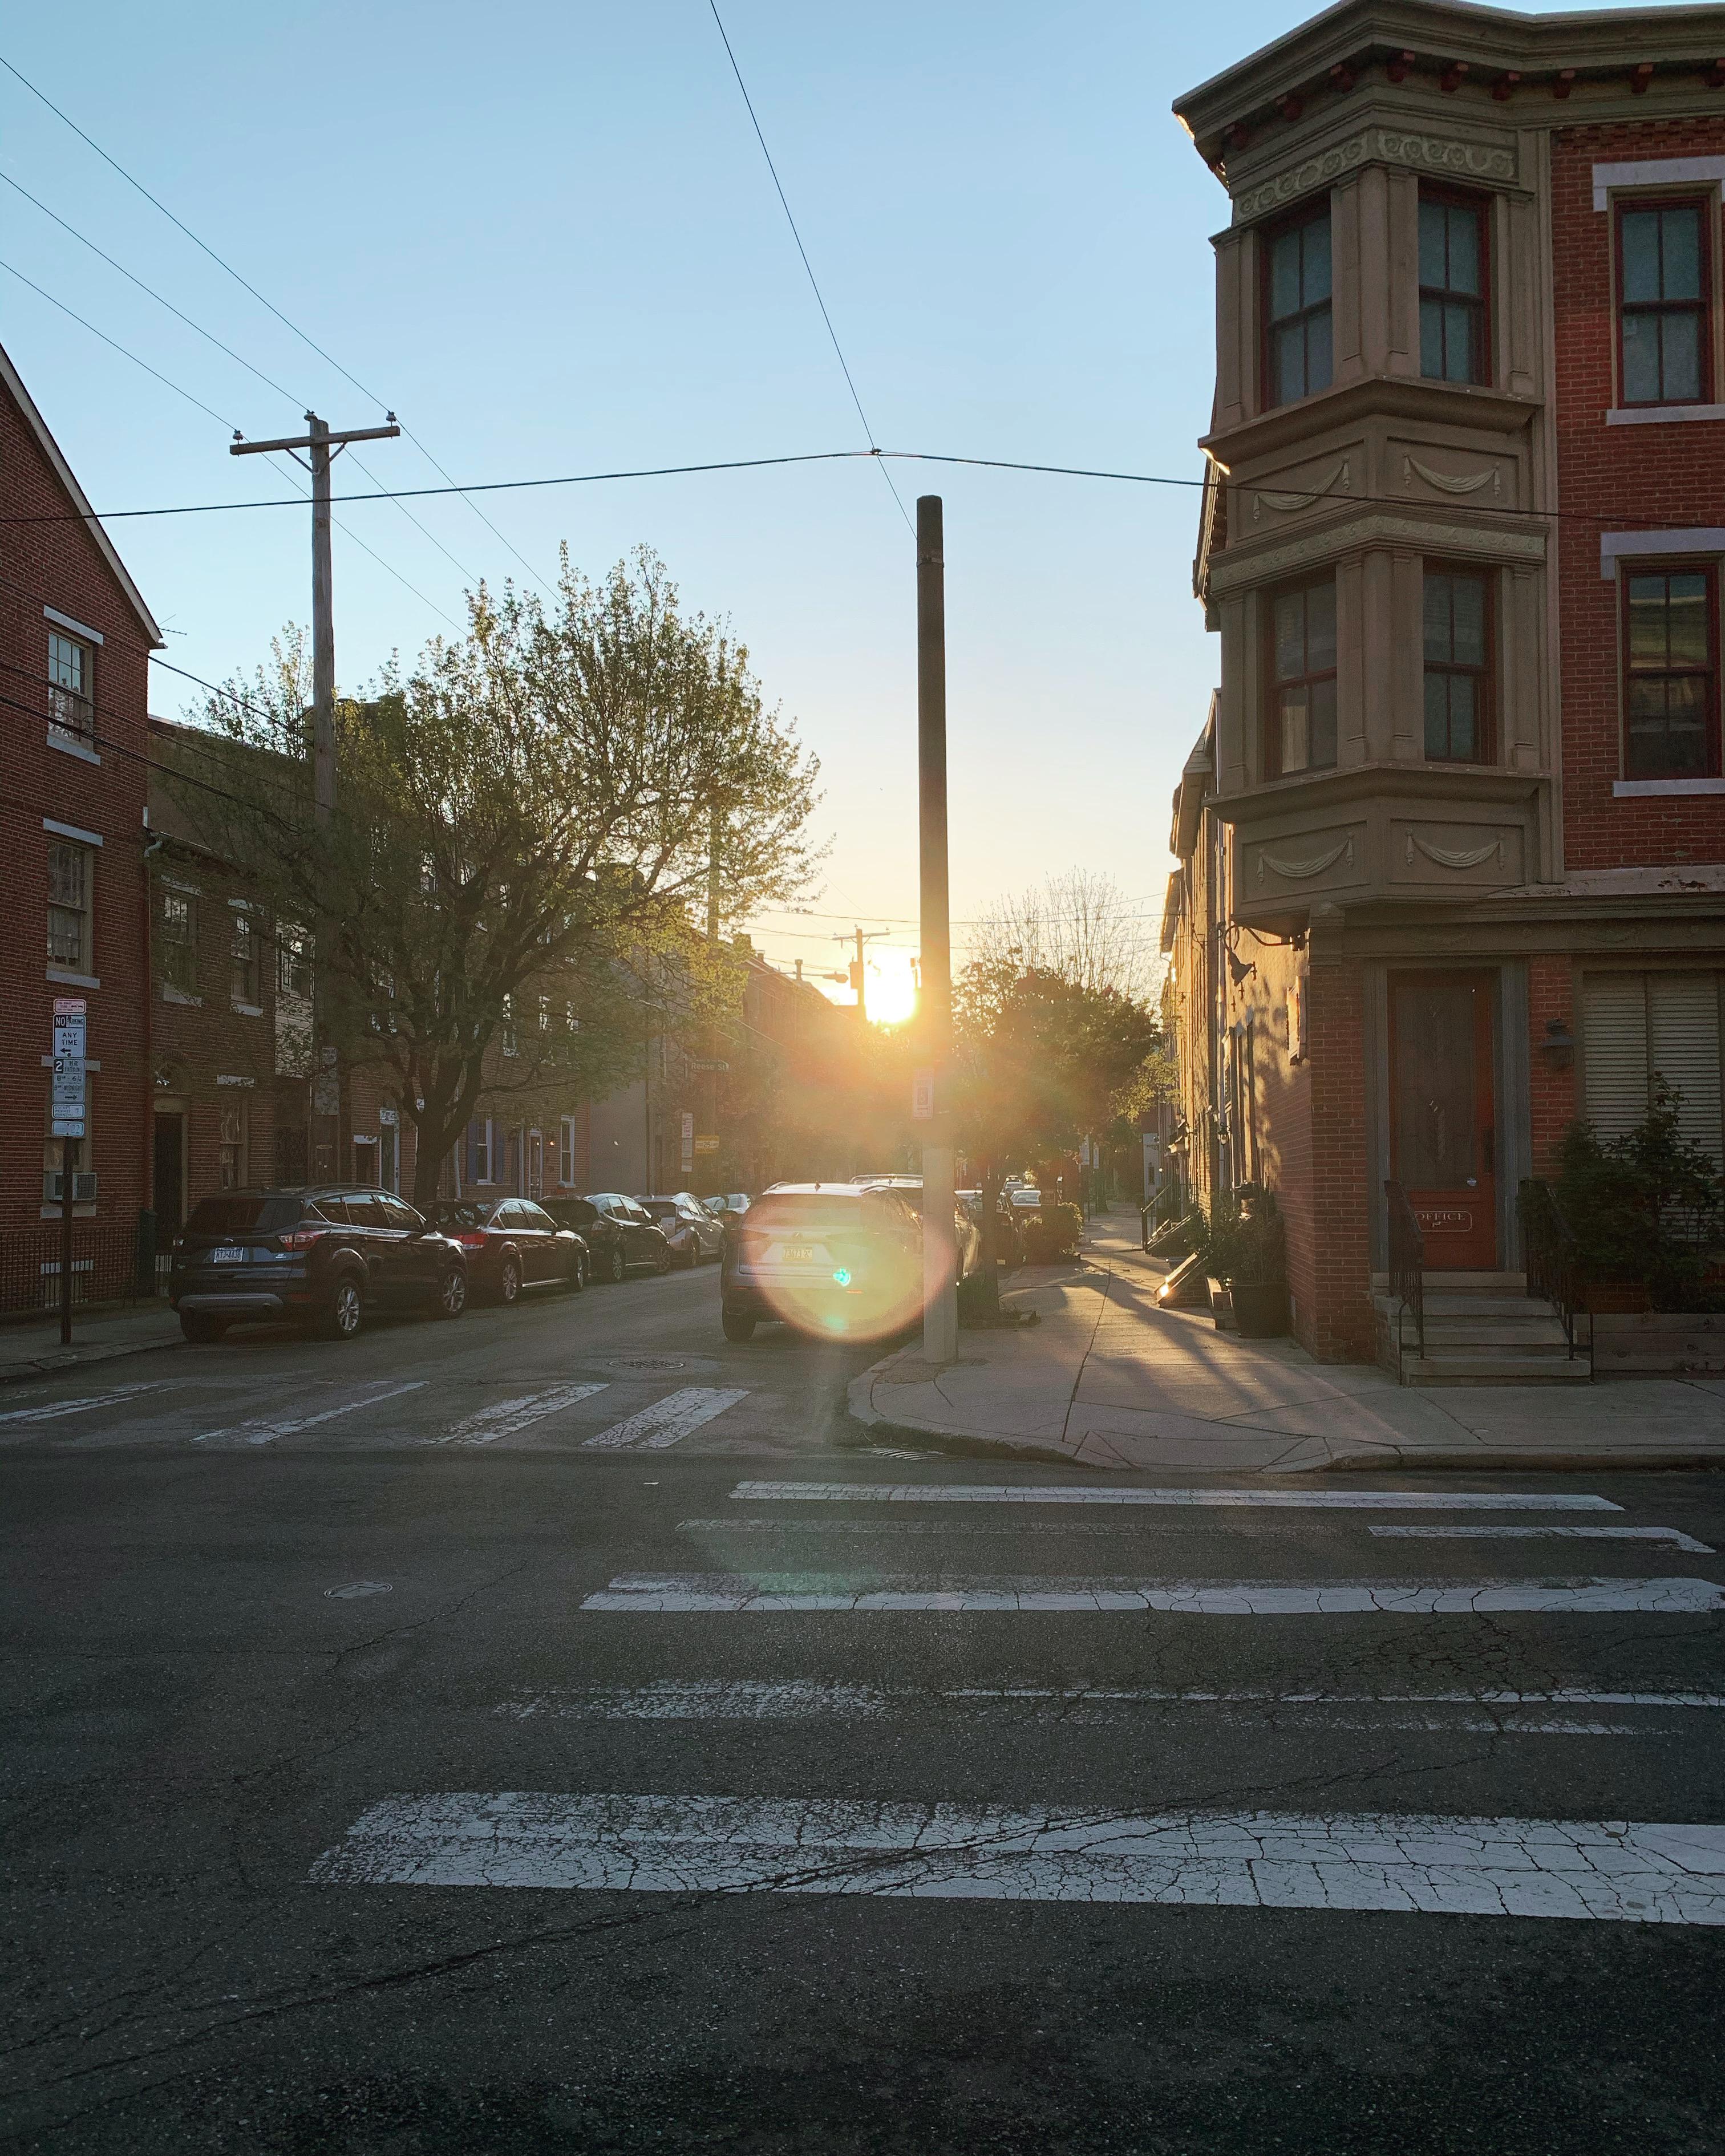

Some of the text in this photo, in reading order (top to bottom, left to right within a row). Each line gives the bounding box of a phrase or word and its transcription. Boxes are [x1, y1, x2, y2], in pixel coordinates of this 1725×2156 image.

[55, 1016, 66, 1026] NO
[55, 1060, 63, 1072] 2
[691, 1062, 715, 1071] Reese
